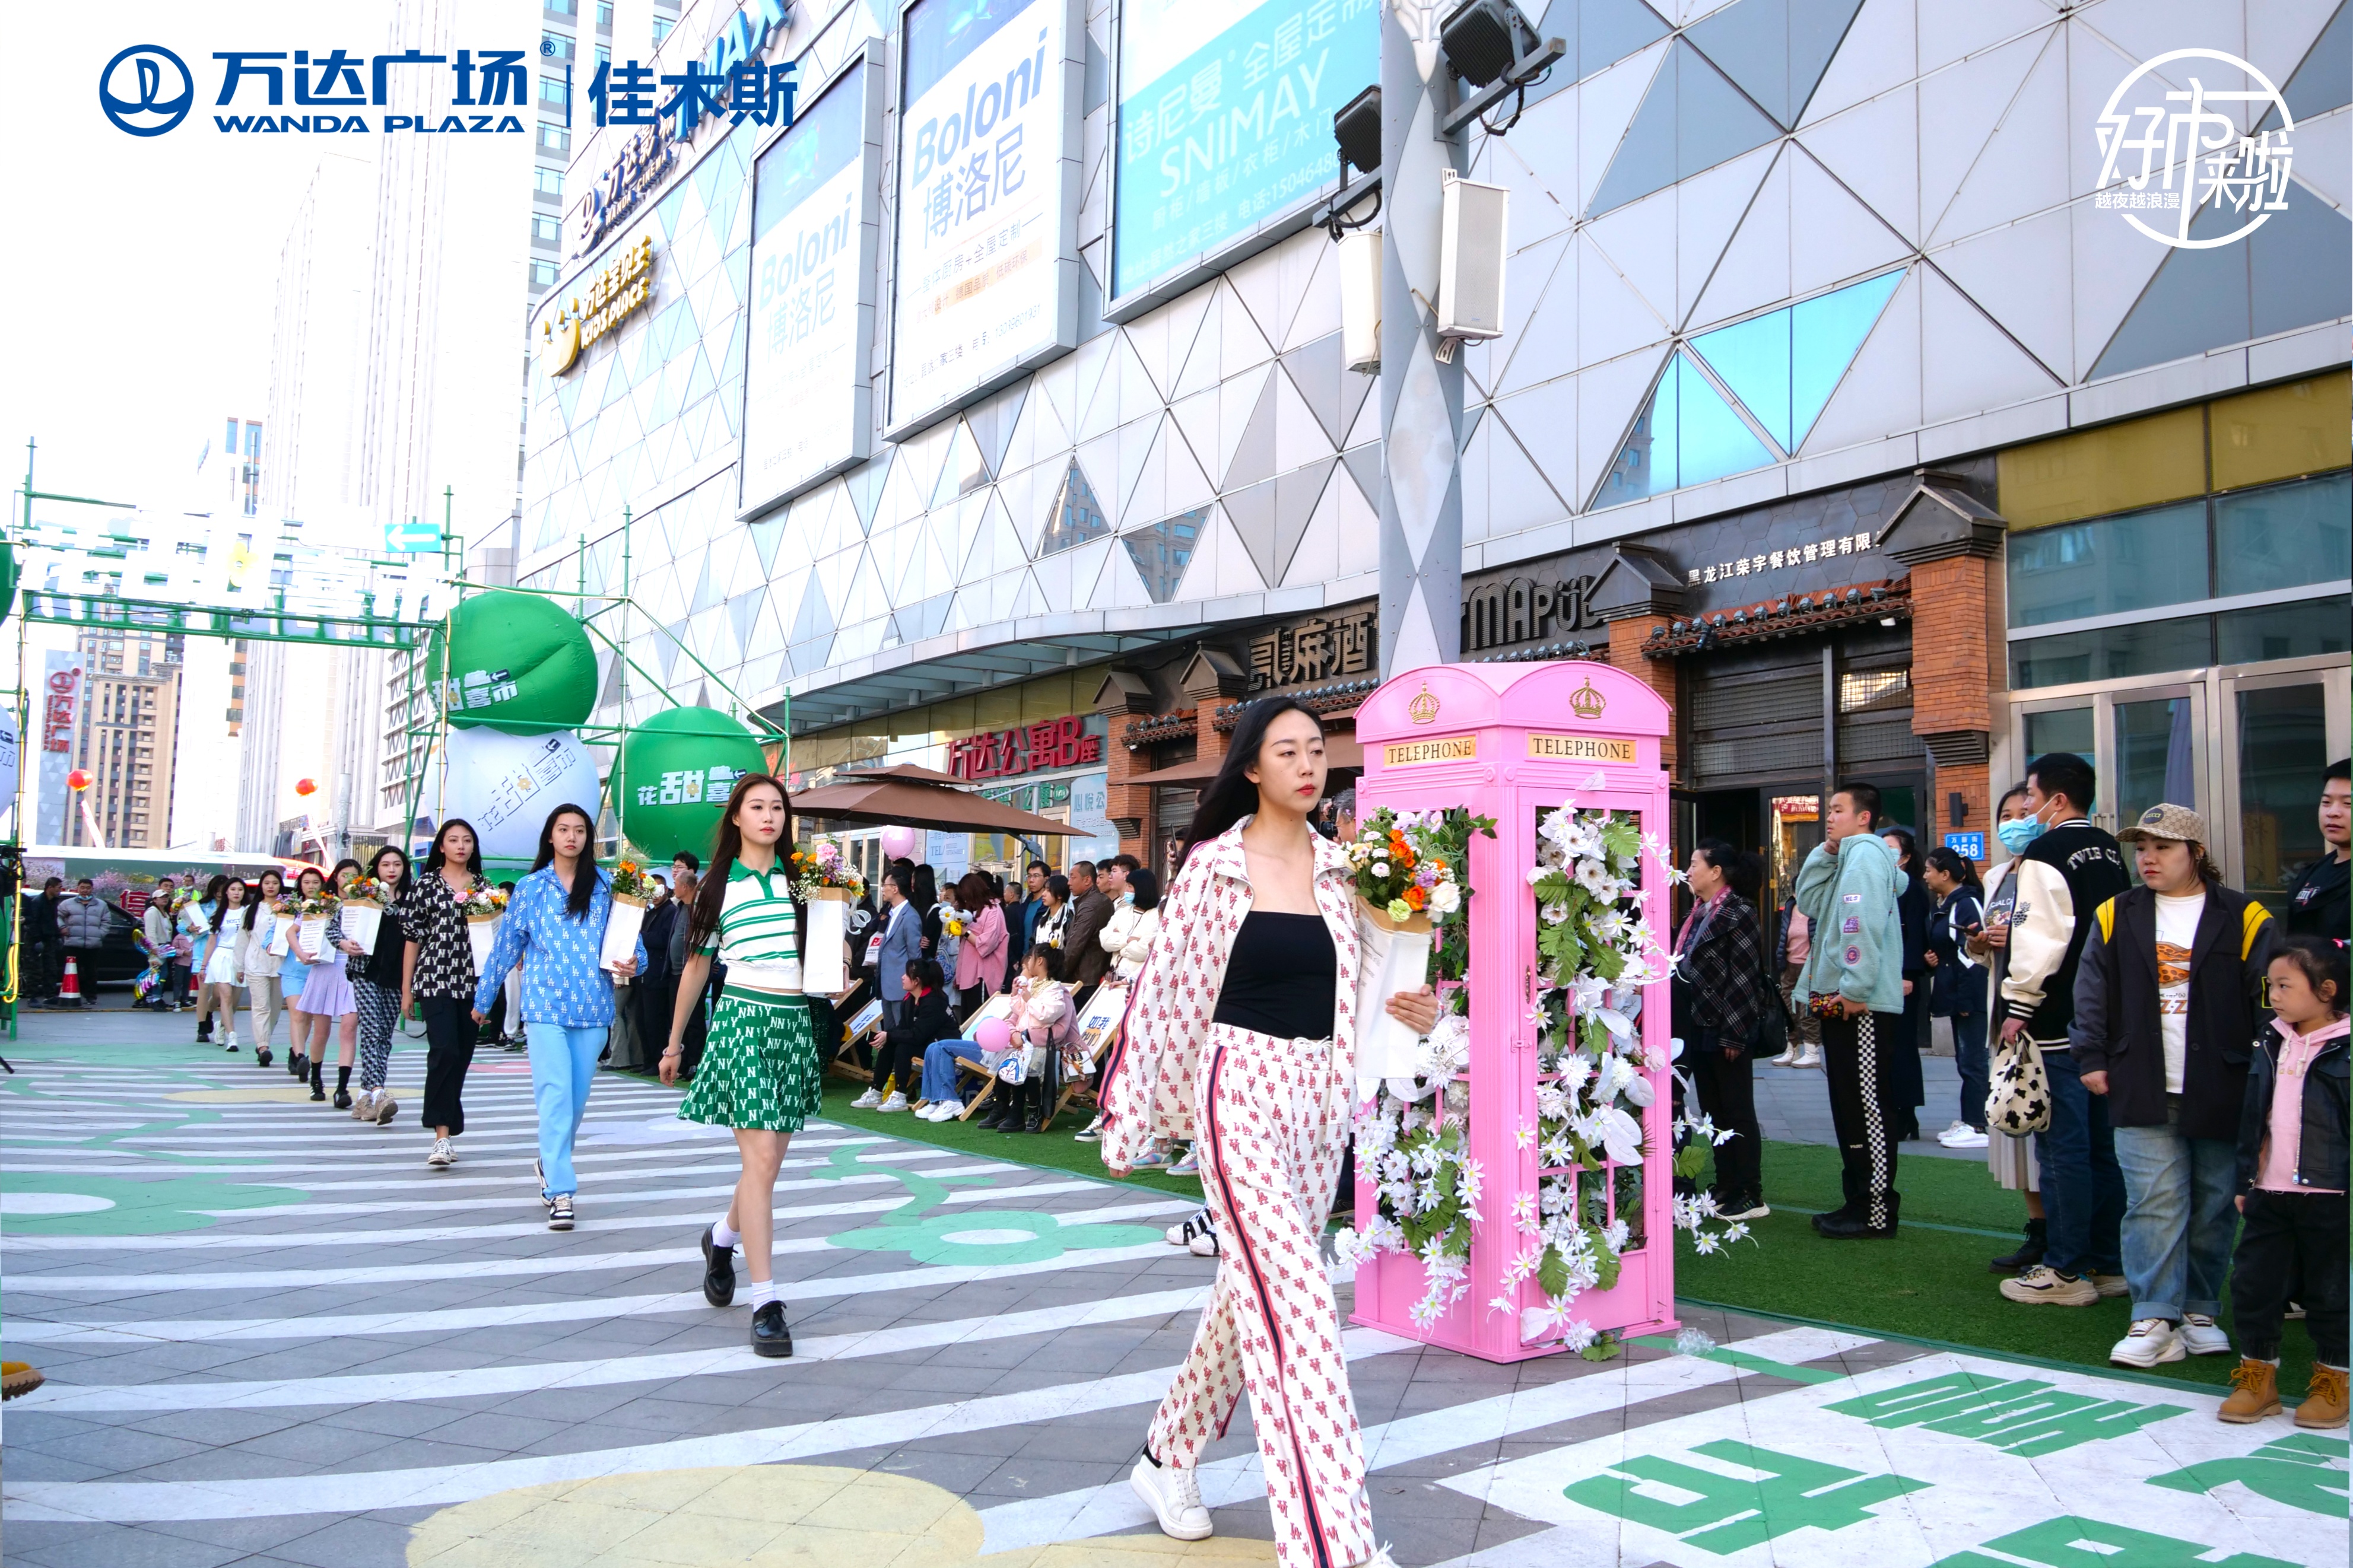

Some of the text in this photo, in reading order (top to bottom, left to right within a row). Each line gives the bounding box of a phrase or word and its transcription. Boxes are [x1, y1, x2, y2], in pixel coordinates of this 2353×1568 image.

[912, 27, 1047, 190] Boloni
[1124, 58, 1223, 165] 诗尼曼
[1160, 47, 1329, 198] SNIMAY
[923, 123, 1025, 250] 博洛尼
[579, 235, 652, 320] 万达宝贝王
[759, 192, 853, 312] Boloni
[767, 268, 836, 363] 博洛尼
[1687, 531, 1882, 588] 黑龙江荣宇餐饮管理有限
[1248, 603, 1380, 692] 贰麻酒
[49, 695, 74, 753] 万达广场
[945, 715, 1103, 781] 万达公寓B座
[1388, 742, 1473, 764] TELEPHONE
[1533, 738, 1631, 759] TELEPHONE
[637, 770, 737, 806] 花甜喜
